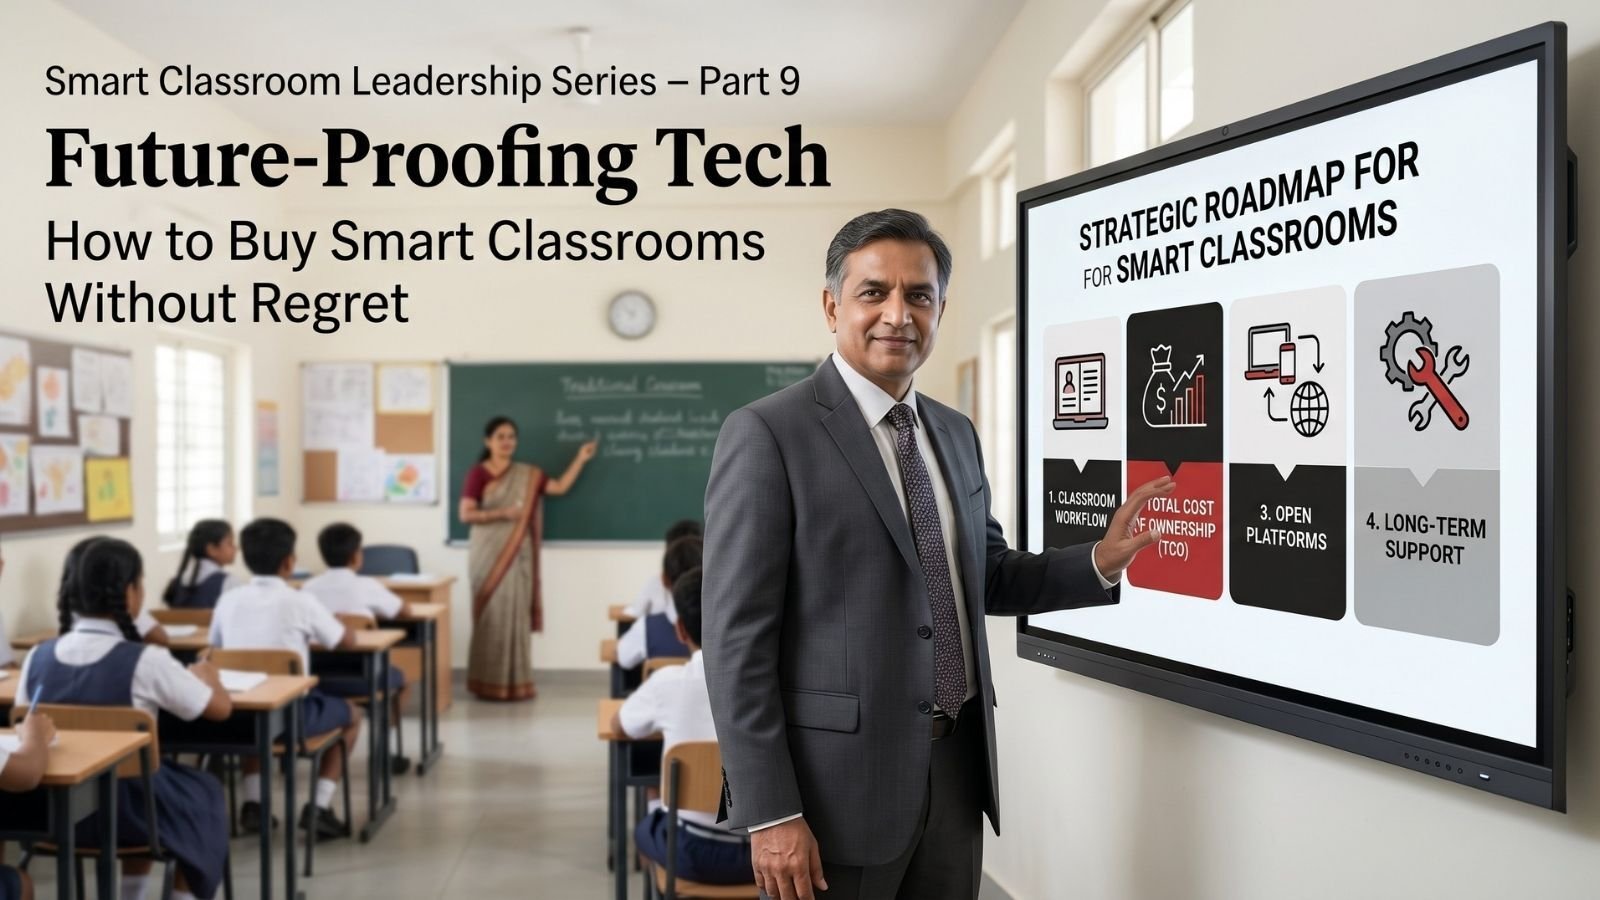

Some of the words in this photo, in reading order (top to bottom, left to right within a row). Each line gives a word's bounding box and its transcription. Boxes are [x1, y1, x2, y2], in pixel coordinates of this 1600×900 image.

[1079, 196, 1198, 251] STRATEGIC
[1205, 160, 1345, 224] ROADMAP
[1355, 141, 1420, 190] FOR
[1083, 265, 1112, 289] FOR
[1116, 240, 1195, 284] SMART
[1200, 199, 1398, 269] CLASSROOMS
[1048, 490, 1057, 504] 1.
[1058, 490, 1116, 508] CLASSROOM
[1147, 497, 1181, 514] TOTAL
[1183, 498, 1215, 516] COST
[1055, 509, 1108, 528] WORKFLOW
[1260, 504, 1272, 521] 3.
[1275, 505, 1312, 524] OPEN
[1365, 511, 1380, 531] 4.
[1384, 512, 1486, 539] LONG-TERM
[1148, 518, 1216, 539] OWNERSHIP
[1246, 526, 1327, 551] PLATFORMS
[1158, 539, 1189, 562] (TCO)
[1385, 539, 1465, 565] SUPPORT
